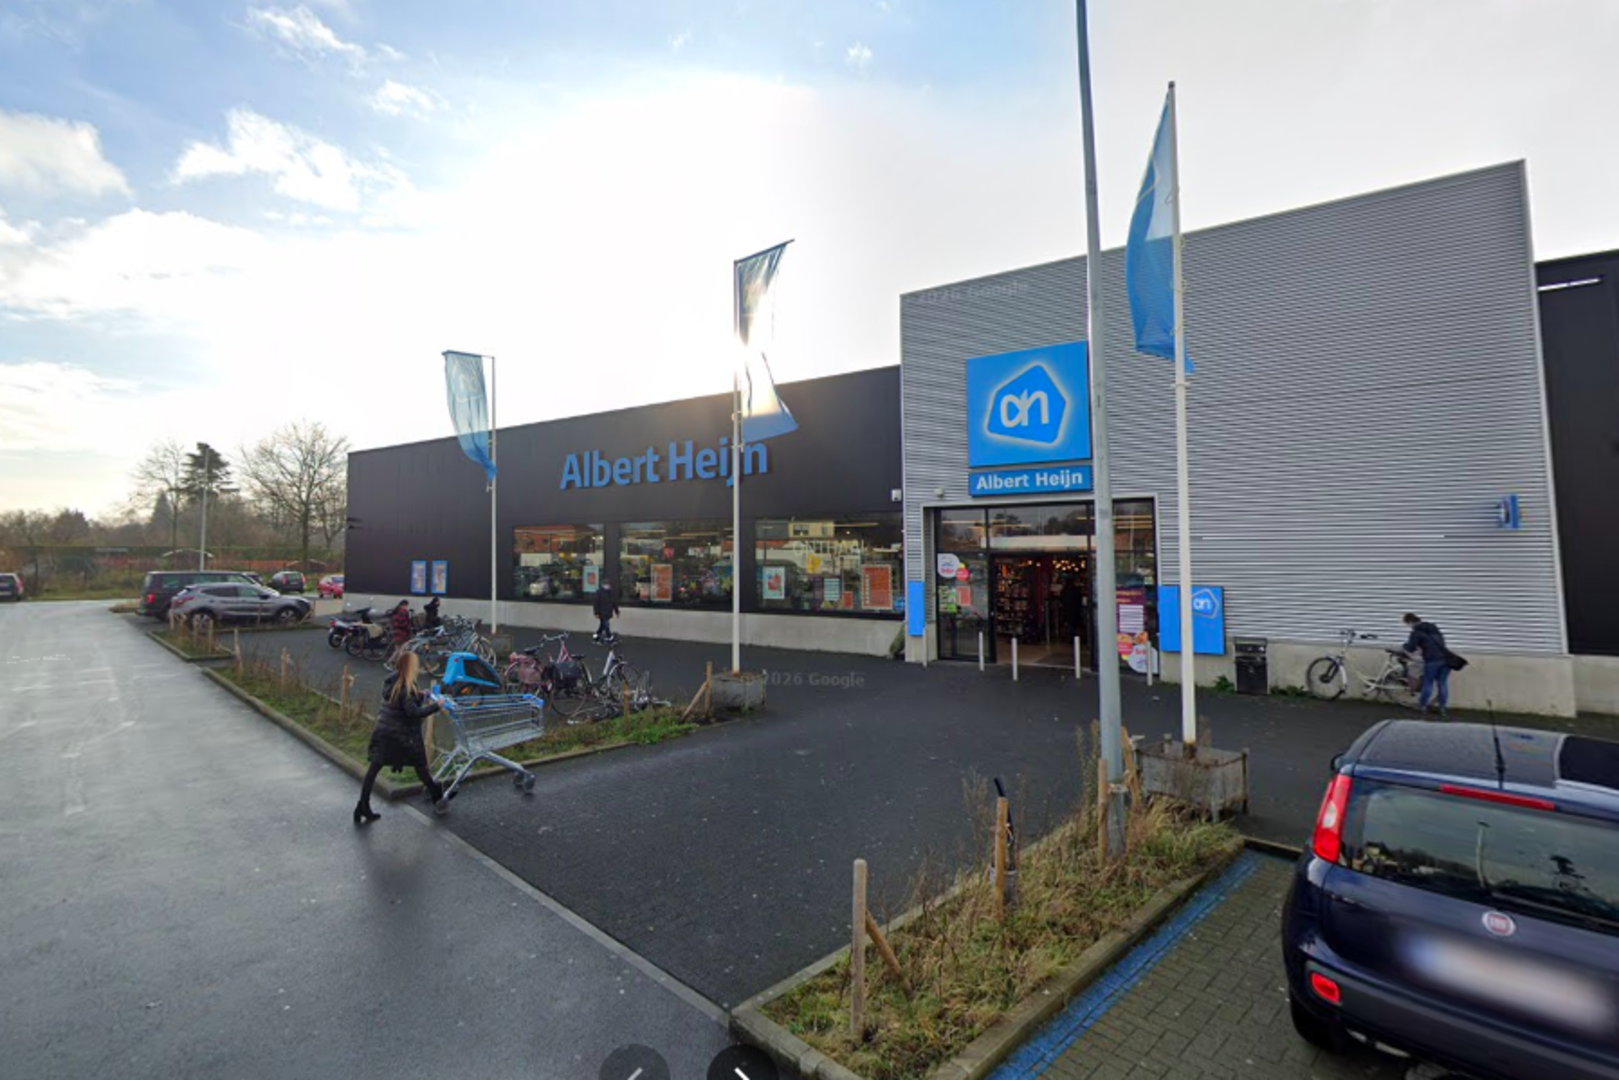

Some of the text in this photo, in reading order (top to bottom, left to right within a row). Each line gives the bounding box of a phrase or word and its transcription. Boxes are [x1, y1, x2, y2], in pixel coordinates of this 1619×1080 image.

[559, 447, 659, 490] Albert
[976, 469, 1083, 490] Albert Heijn
